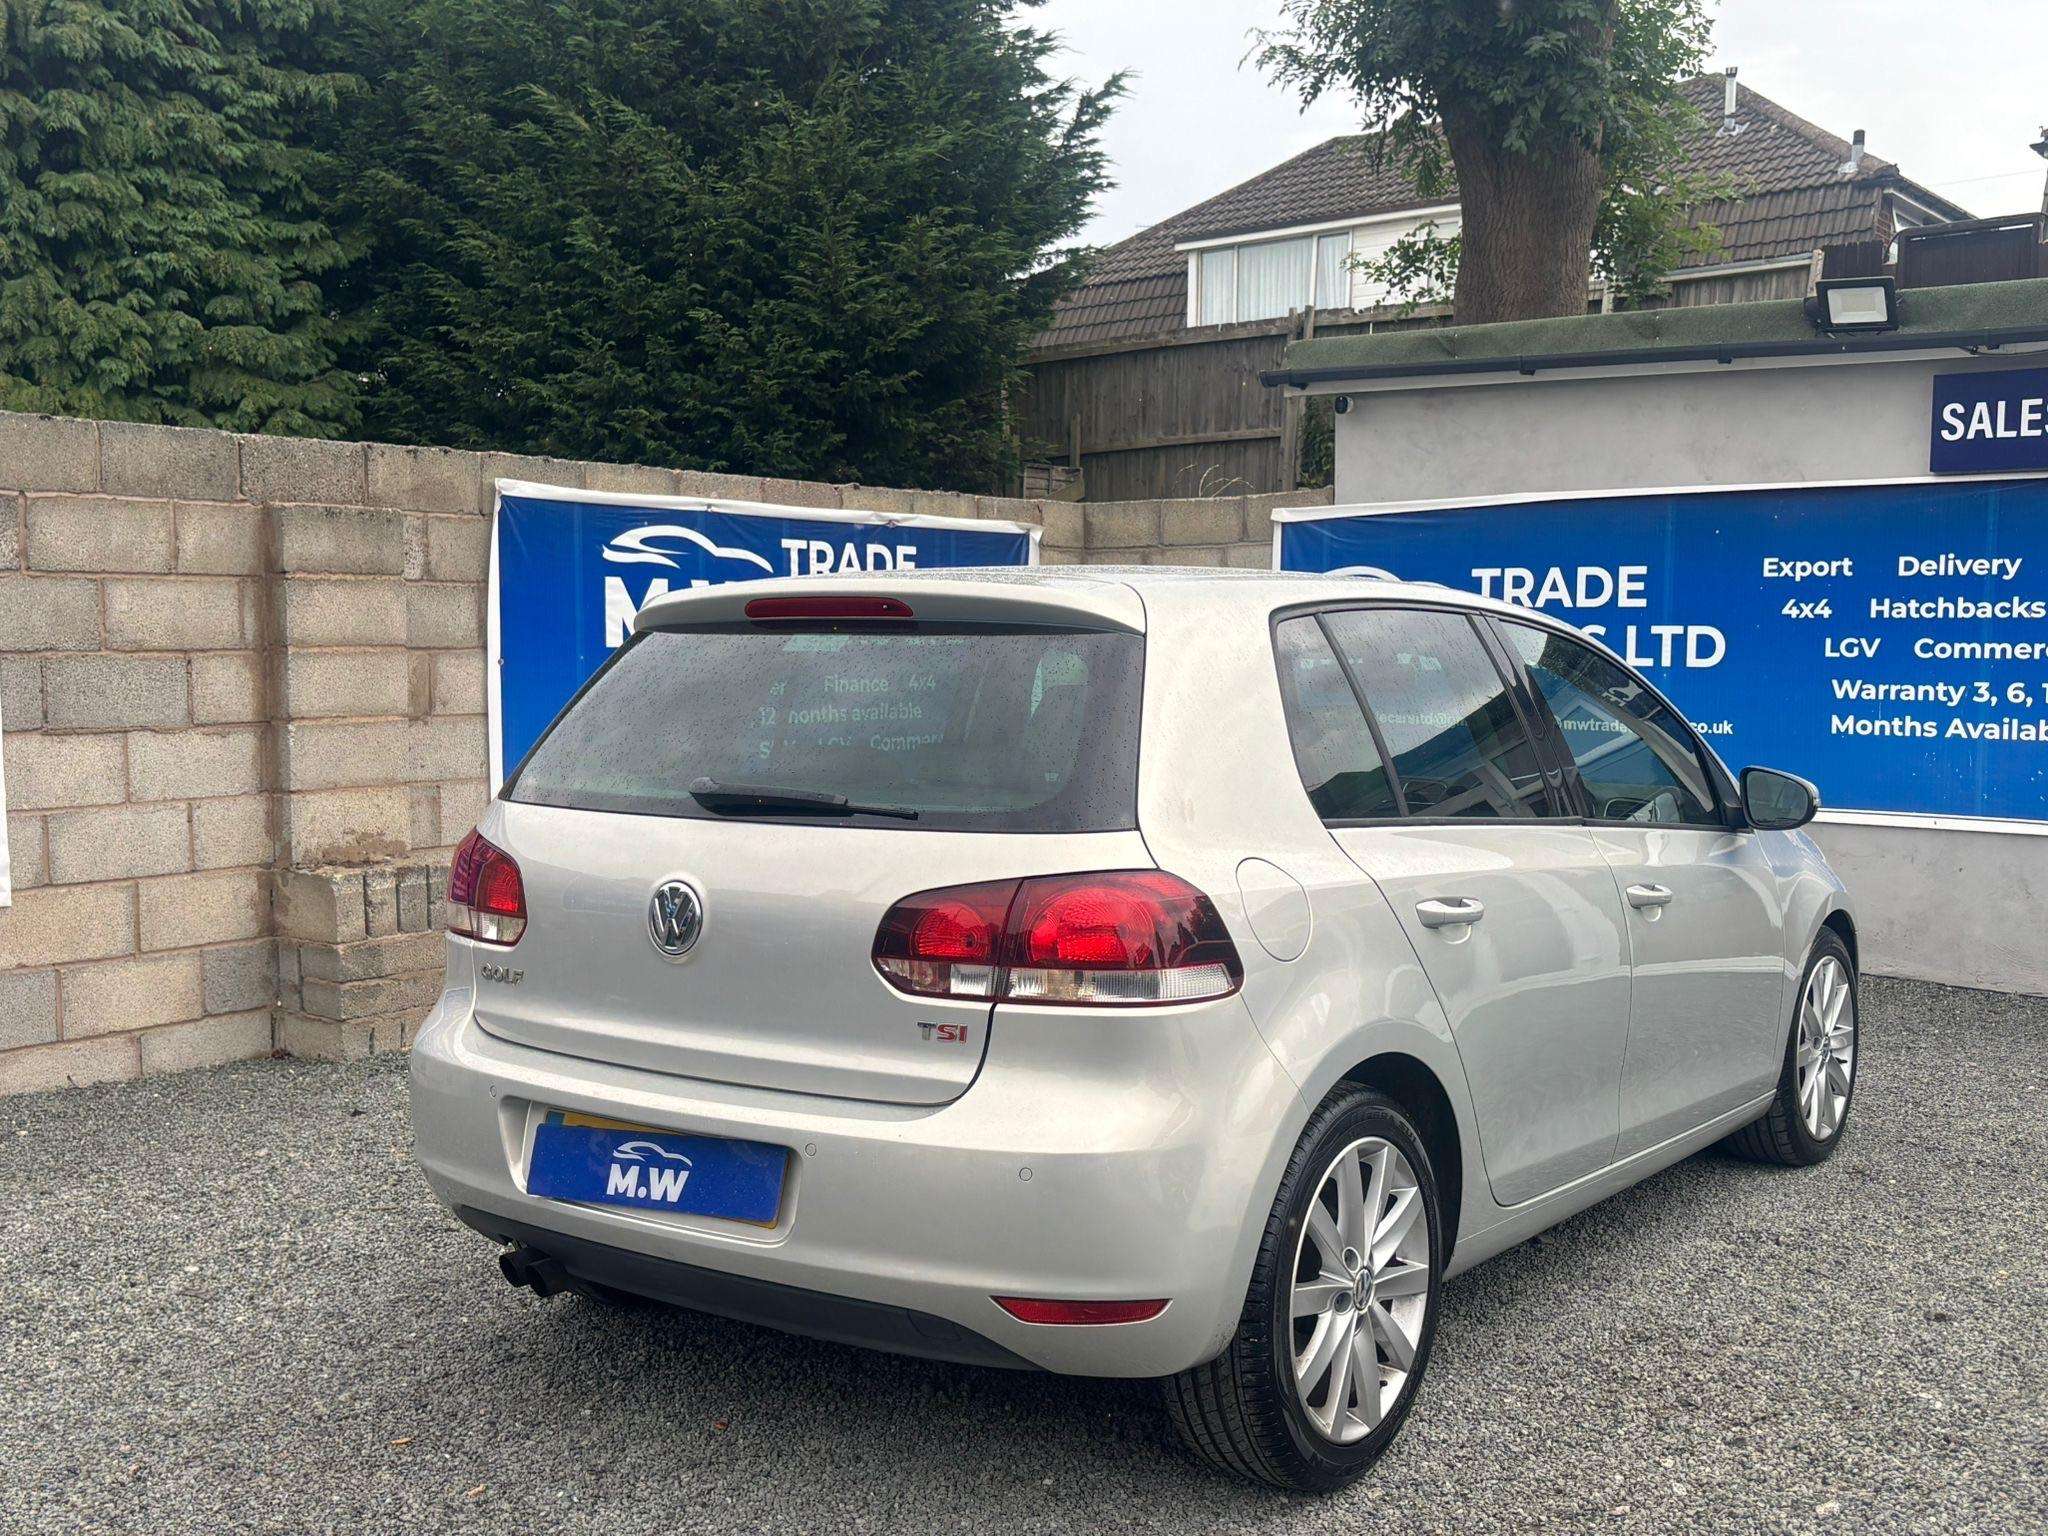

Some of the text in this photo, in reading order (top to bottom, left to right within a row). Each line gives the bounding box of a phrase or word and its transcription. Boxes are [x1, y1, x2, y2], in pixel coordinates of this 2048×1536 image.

[781, 538, 917, 577] TRADE
[1762, 553, 2022, 581] Export Delivery
[1471, 565, 1648, 608] TRADE
[1781, 596, 2047, 620] 4x4 Hatchbacks
[1624, 625, 1727, 668] LTD
[1824, 637, 2048, 660] LGV Commer
[824, 674, 889, 693] Finance
[1831, 679, 1966, 707] Warranty
[1972, 682, 1998, 707] 3,
[2006, 682, 2033, 708] 6,
[852, 702, 923, 721] available
[1831, 714, 1938, 738] Months
[480, 961, 525, 985] GOLF
[916, 1021, 968, 1043] TSI
[606, 1163, 690, 1203] M.W
